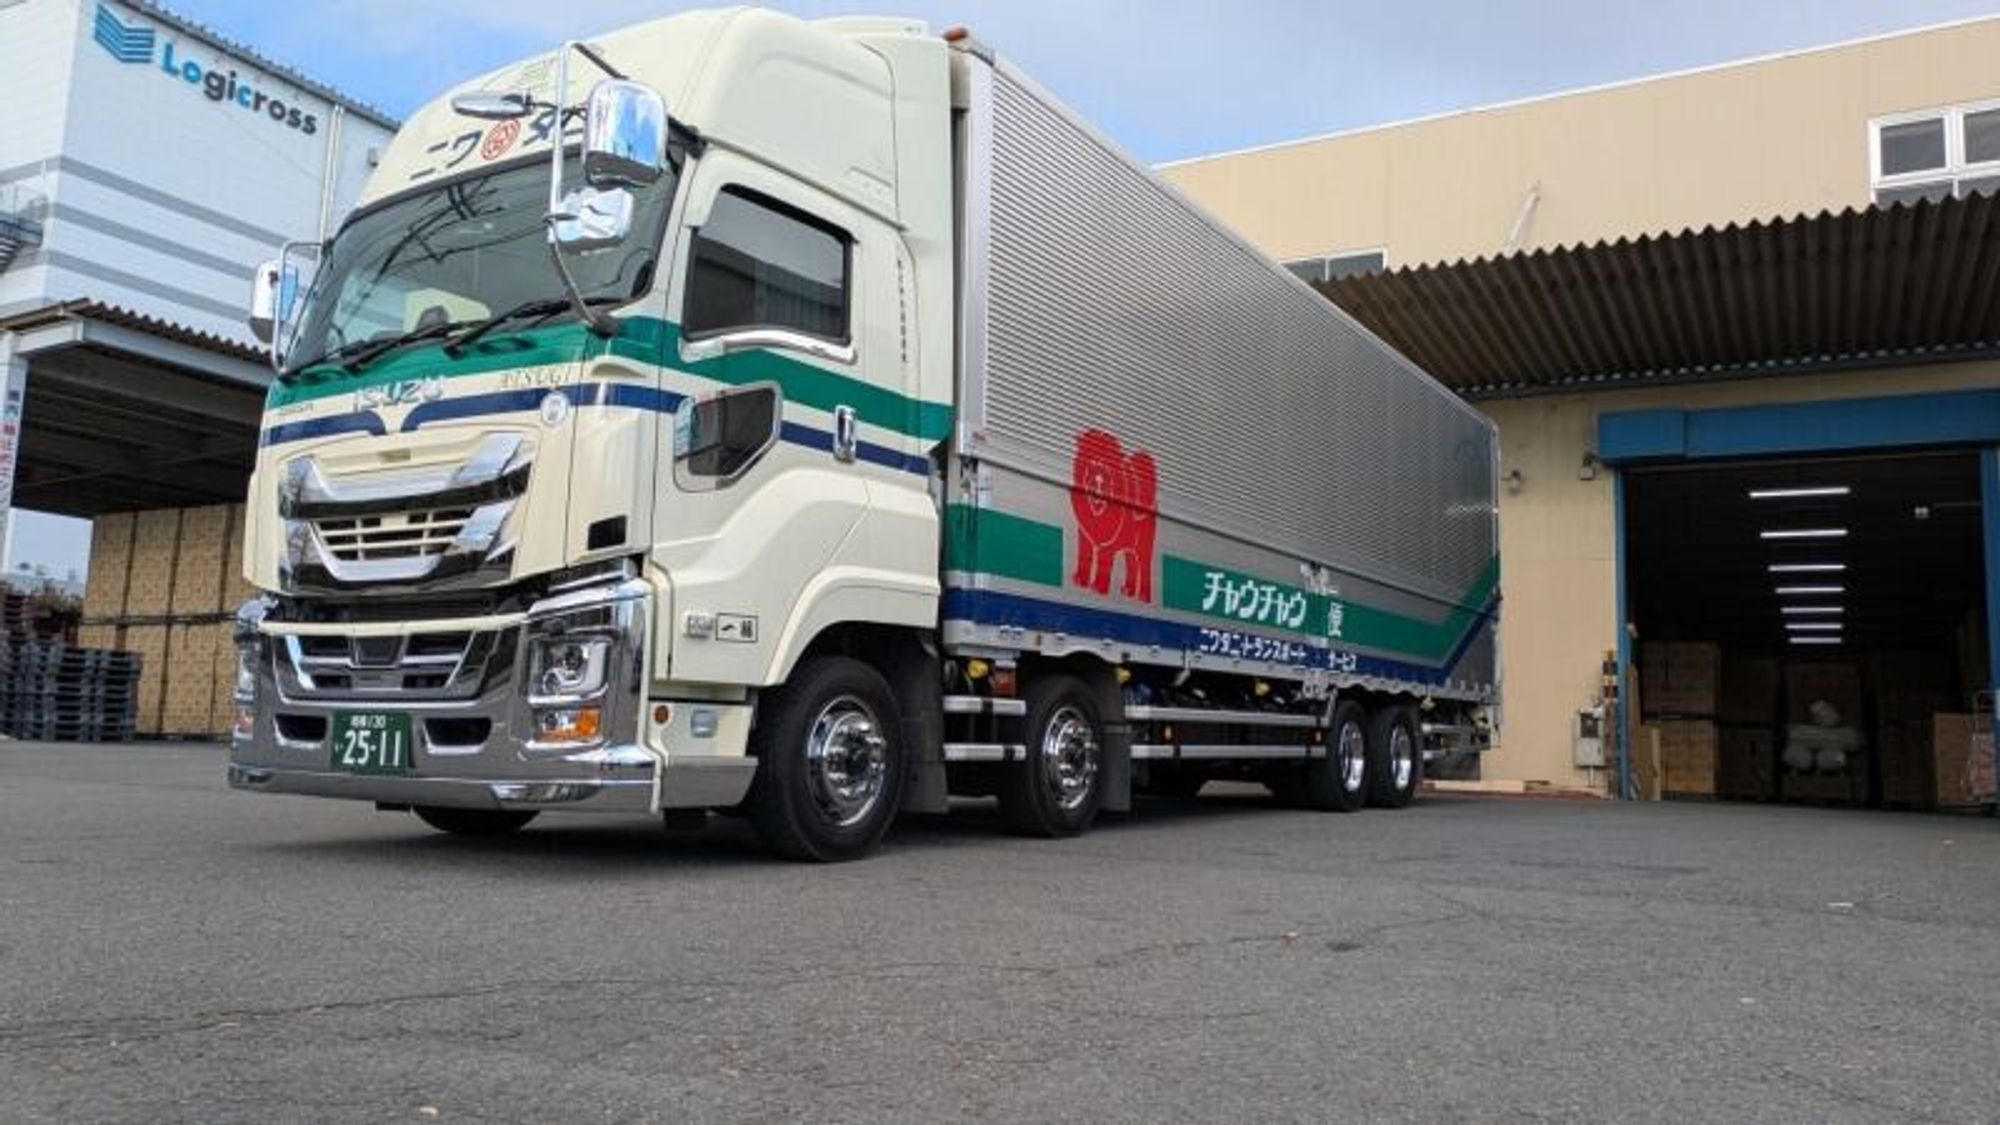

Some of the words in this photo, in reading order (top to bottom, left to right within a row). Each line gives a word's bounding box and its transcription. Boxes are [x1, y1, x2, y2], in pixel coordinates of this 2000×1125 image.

[161, 42, 318, 136] Logicross
[353, 374, 443, 412] ISUZU
[1202, 571, 1307, 628] チャウチャウ
[342, 729, 402, 767] 25-11
